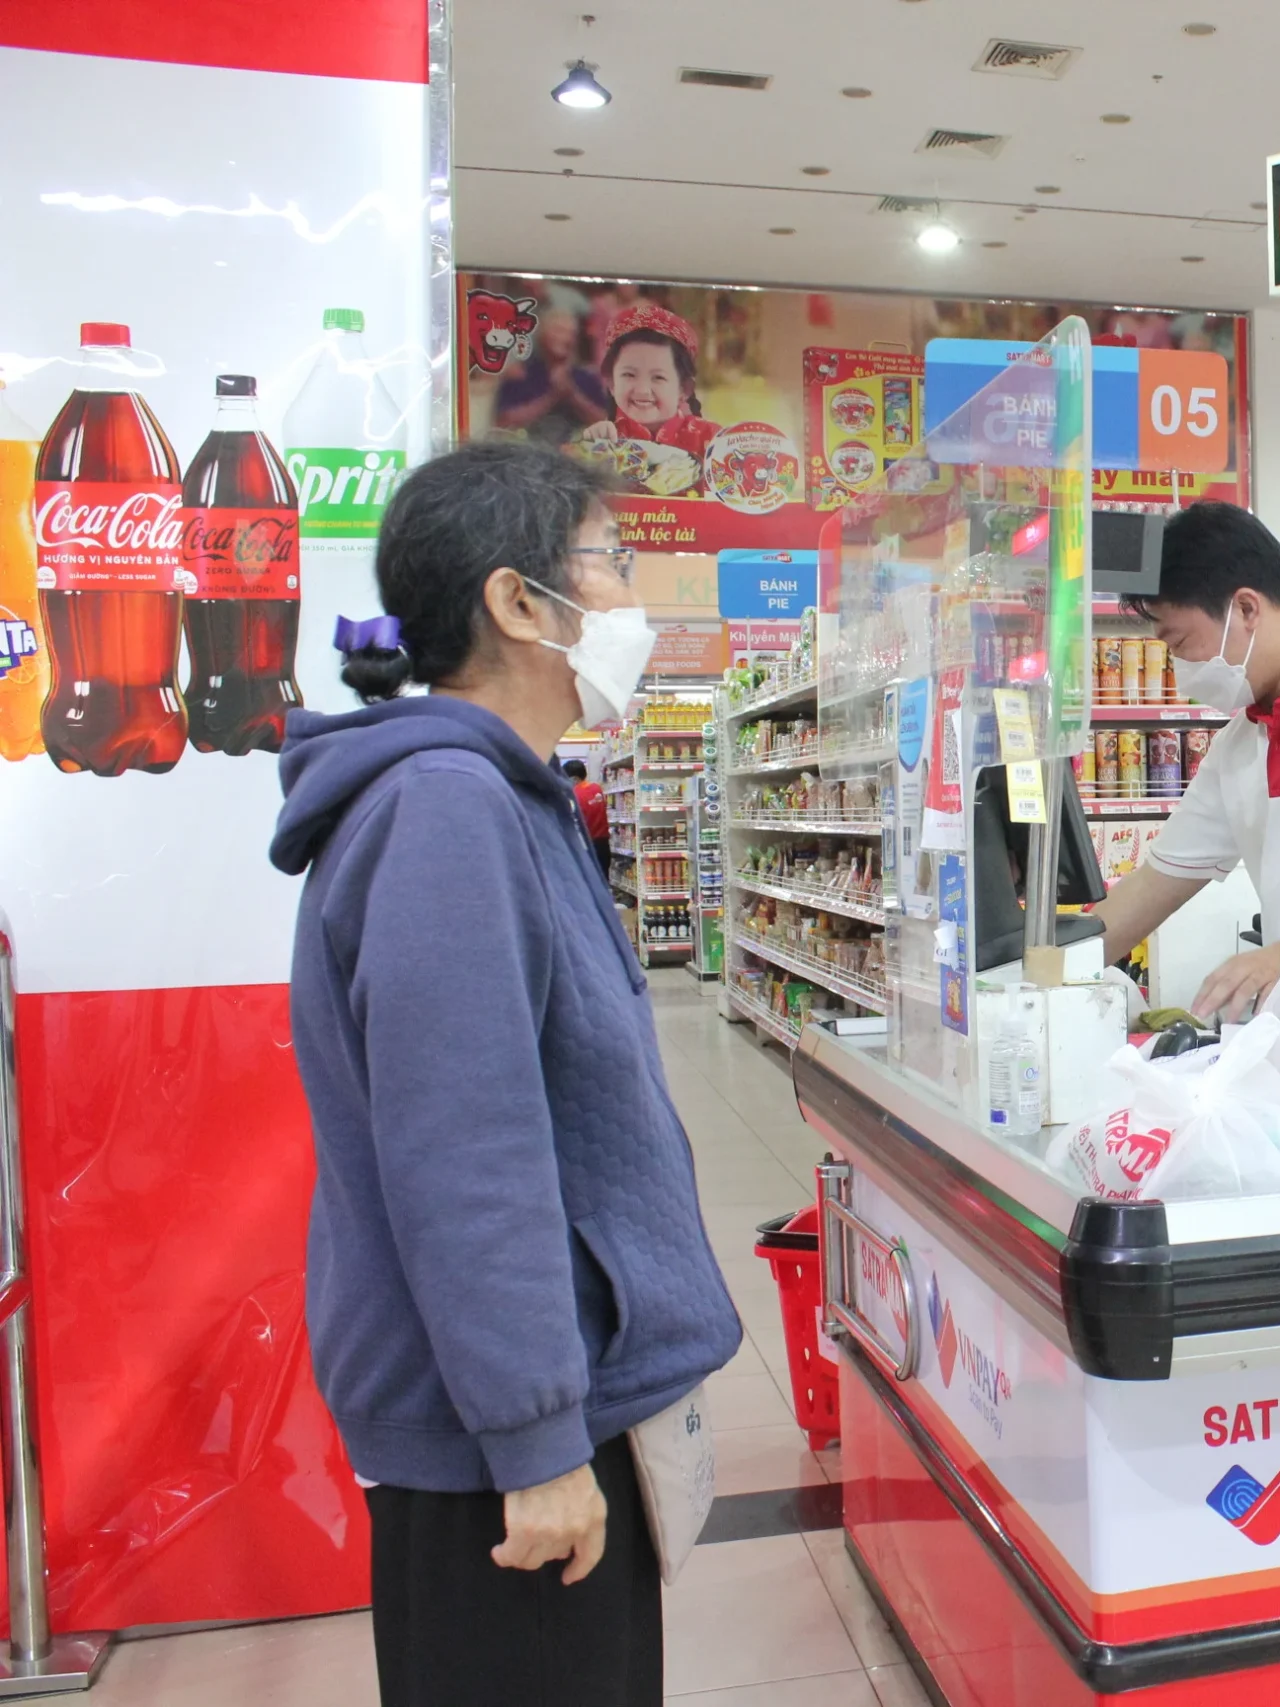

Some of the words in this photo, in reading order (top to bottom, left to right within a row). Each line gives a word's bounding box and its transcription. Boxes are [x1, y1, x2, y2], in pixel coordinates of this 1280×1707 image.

[1003, 393, 1057, 417] BÁNH
[1150, 385, 1219, 438] 05
[1016, 430, 1048, 449] PIE
[286, 453, 402, 517] Sprit
[36, 490, 184, 550] Coca-Cola
[650, 526, 671, 544] lộc
[675, 527, 696, 542] tài
[44, 554, 85, 565] HƯƠNG
[89, 555, 101, 566] VỊ
[105, 554, 152, 566] NGUYÊN
[155, 553, 180, 566] BẢN
[205, 567, 232, 576] ZERO
[759, 577, 798, 592] BÁNH
[768, 598, 789, 610] PIE
[676, 661, 701, 669] FOODS
[1146, 829, 1161, 841] AF
